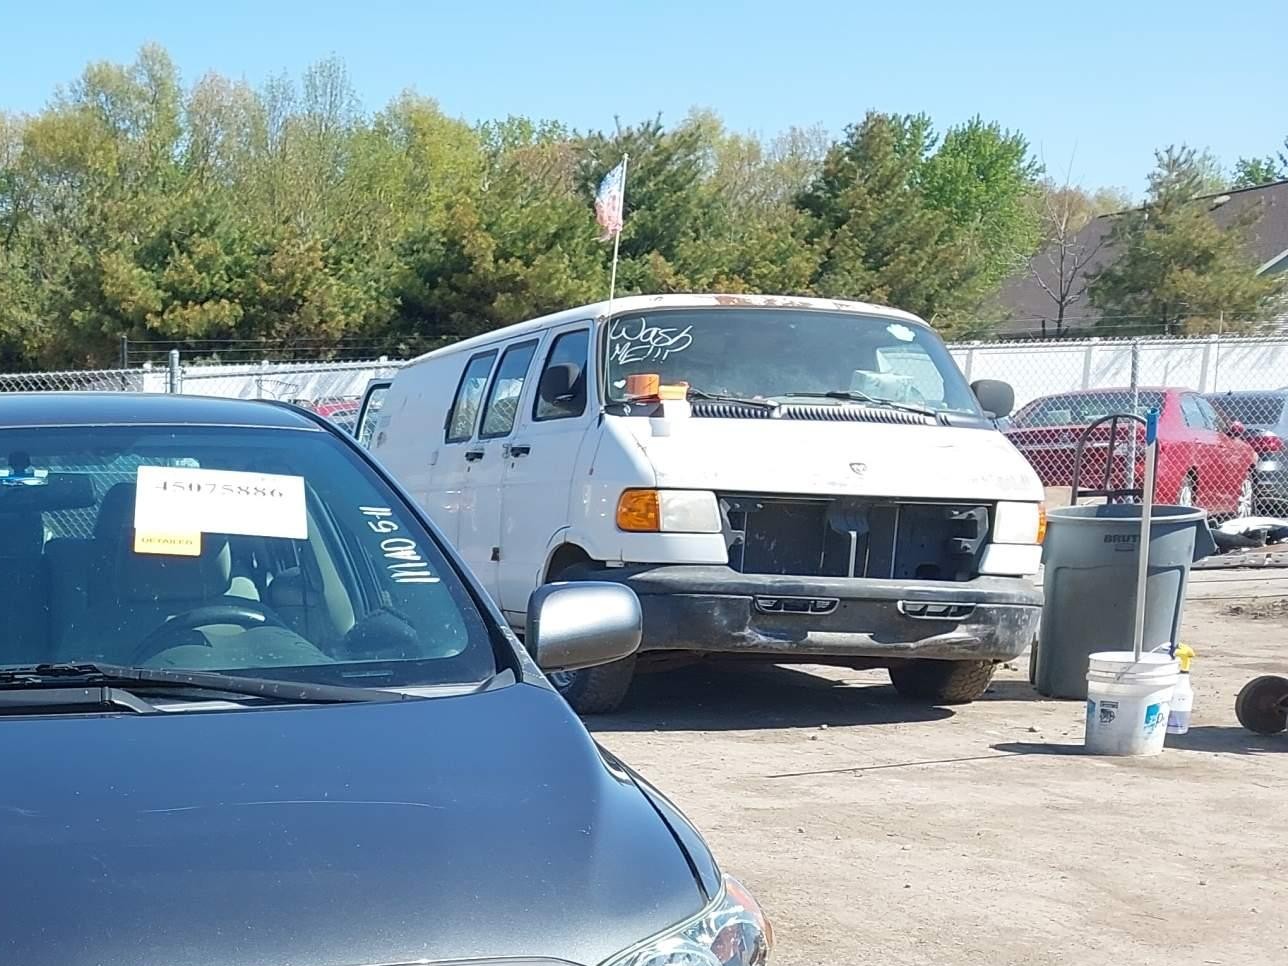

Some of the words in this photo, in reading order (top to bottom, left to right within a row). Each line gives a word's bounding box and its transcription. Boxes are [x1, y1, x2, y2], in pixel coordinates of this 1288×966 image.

[610, 317, 693, 352] Wash
[155, 481, 284, 498] 45075886
[1103, 533, 1141, 544] BRUT
